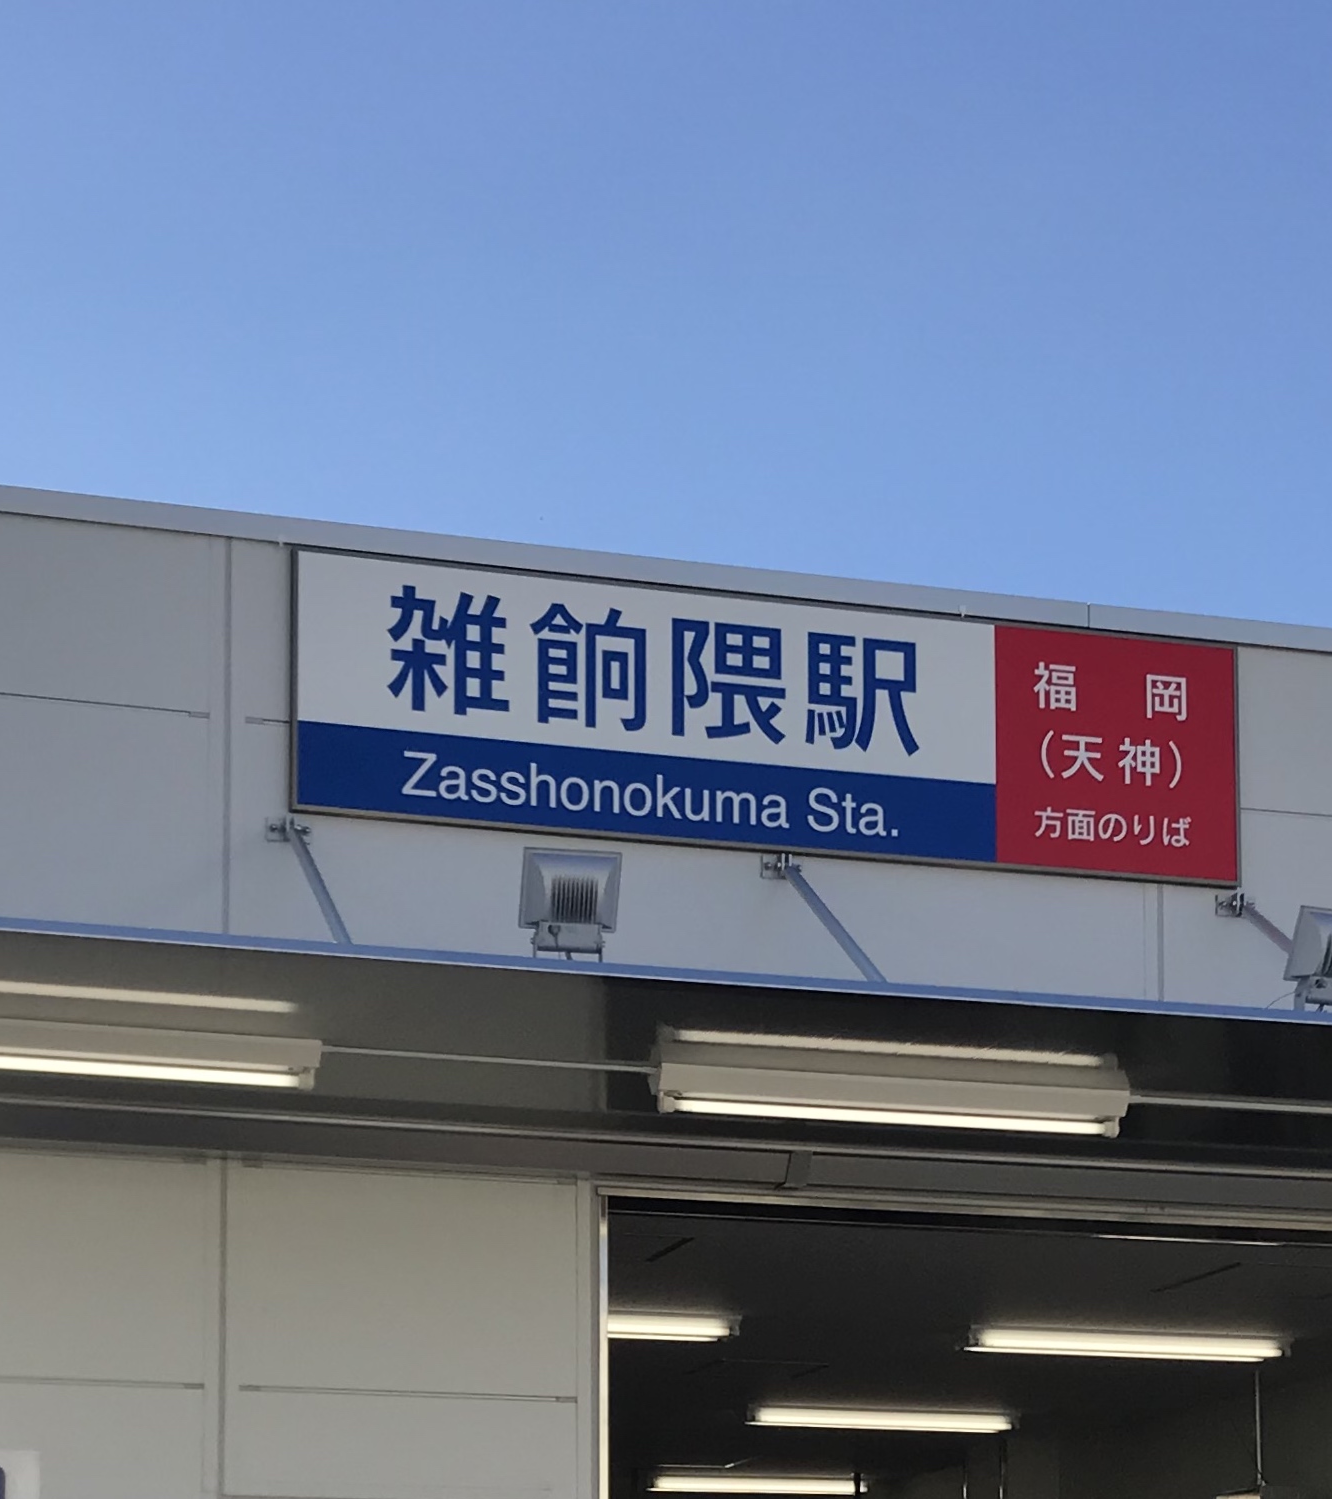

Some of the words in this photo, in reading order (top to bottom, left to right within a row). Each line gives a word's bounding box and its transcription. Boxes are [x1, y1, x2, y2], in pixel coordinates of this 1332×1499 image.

[386, 584, 919, 757] 雑餉隈駅
[1032, 660, 1188, 722] 福岡
[1036, 733, 1182, 789] (天神)
[401, 751, 789, 830] Zasshonokuma
[807, 788, 898, 839] Sta.
[1034, 808, 1192, 849] 方面のりば
